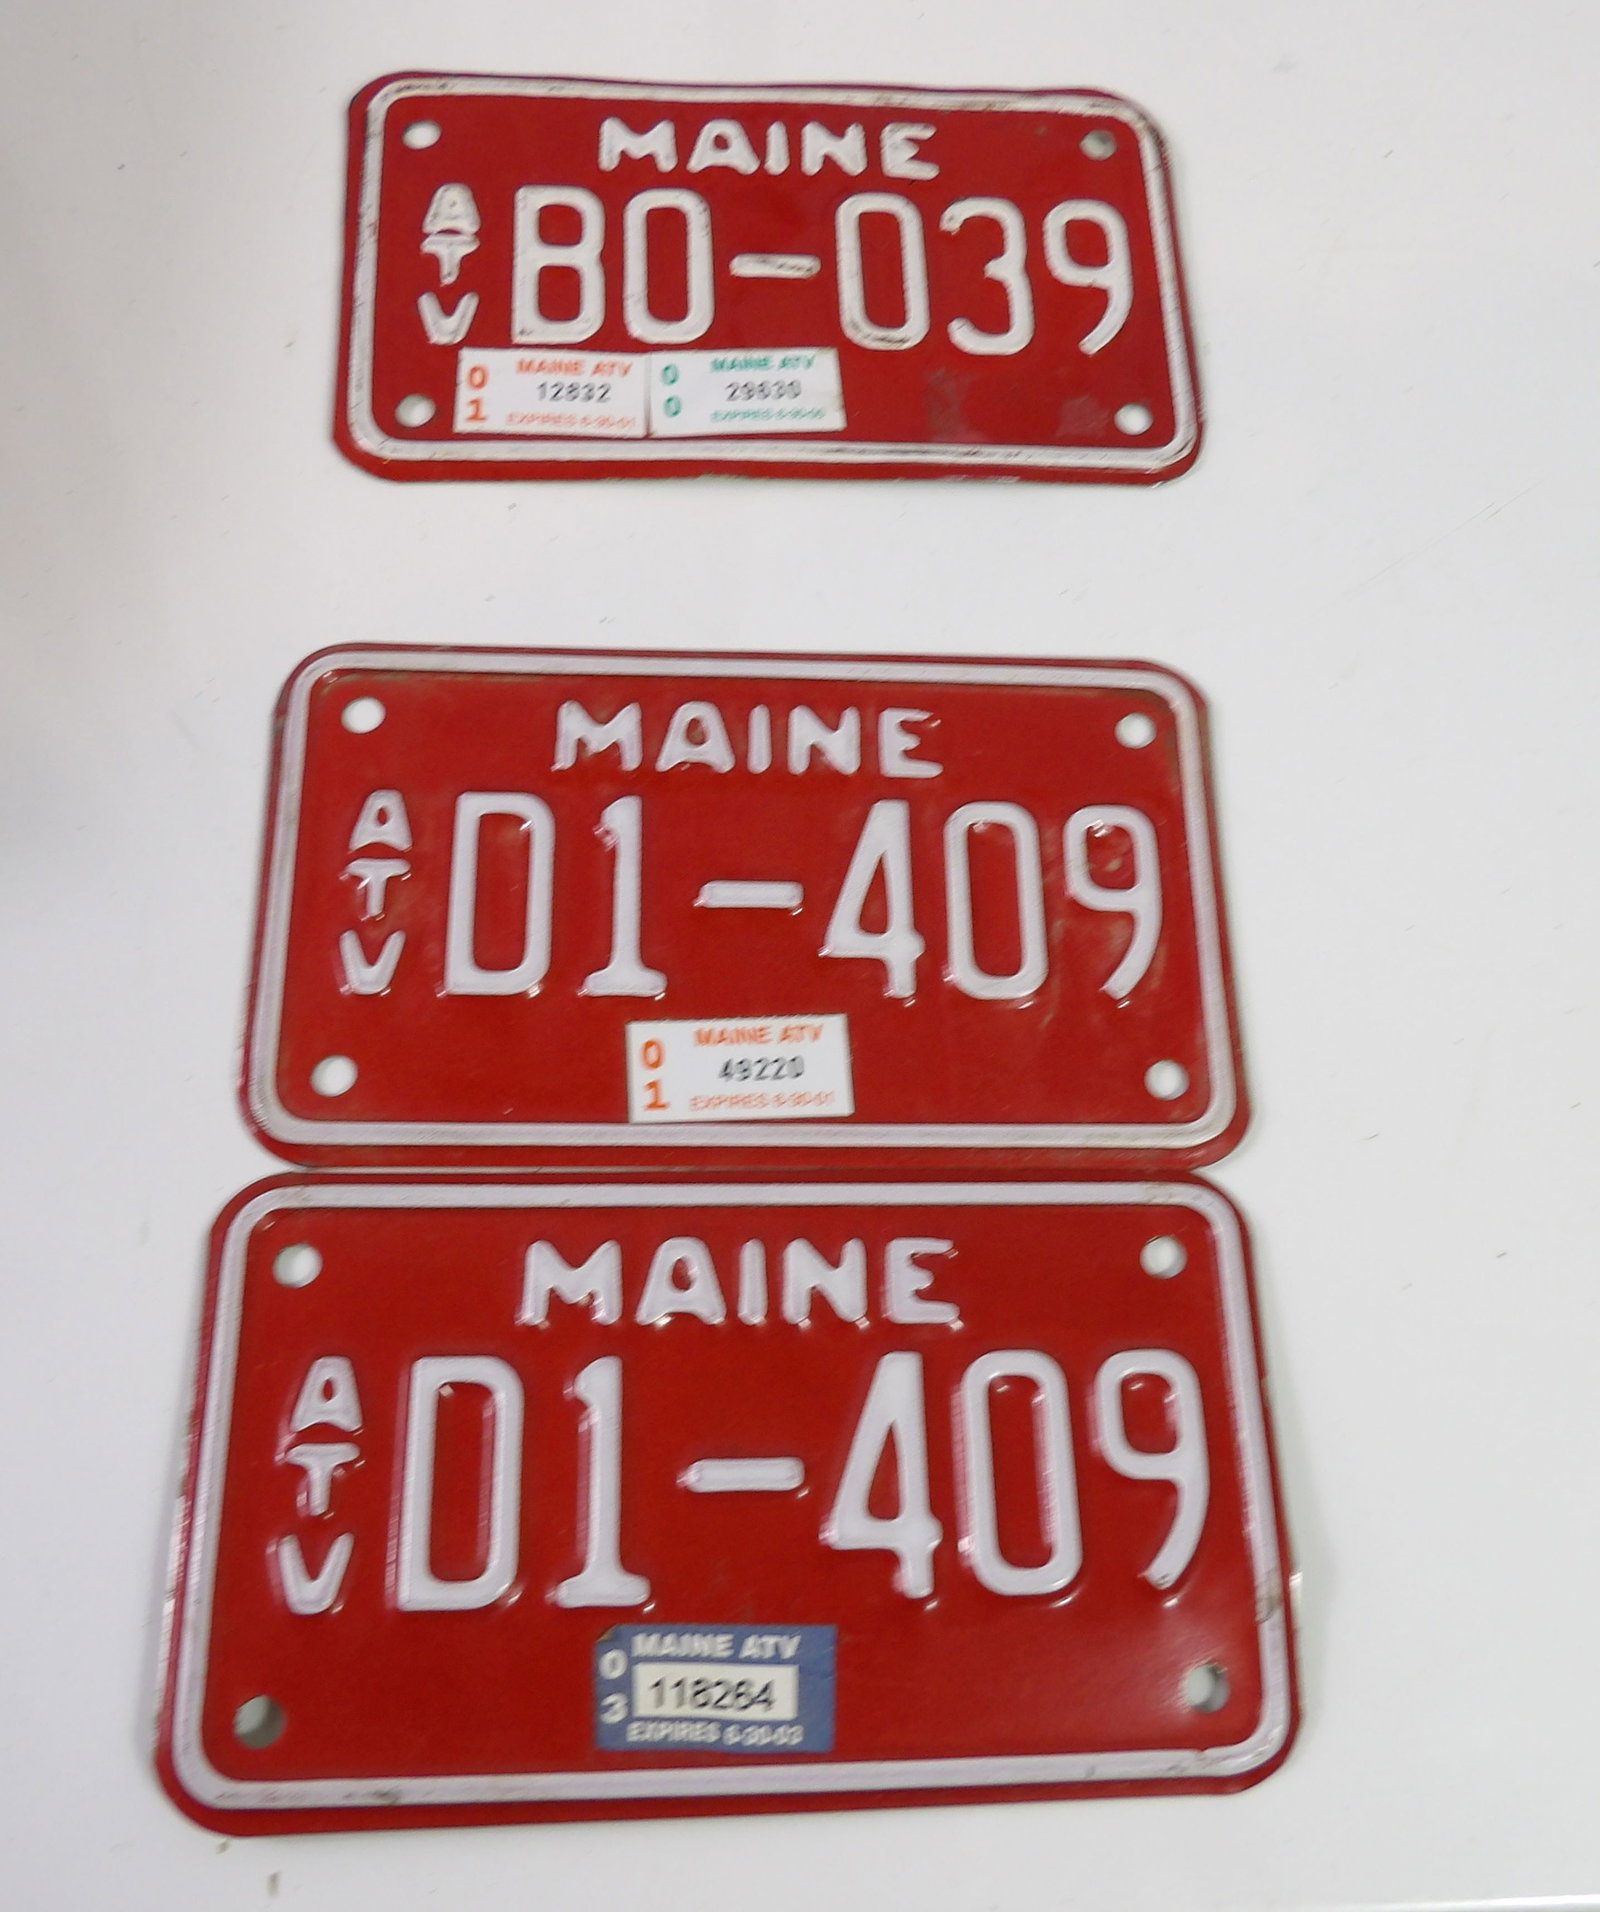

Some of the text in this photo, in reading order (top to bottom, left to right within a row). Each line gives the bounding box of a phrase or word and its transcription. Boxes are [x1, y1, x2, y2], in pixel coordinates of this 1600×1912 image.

[600, 118, 940, 181] MAINE
[418, 182, 481, 345] ATV
[516, 358, 633, 378] MAINE ATV
[711, 354, 816, 373] MAINE ATV
[551, 699, 943, 779] MAINE
[338, 789, 411, 997] ATV
[440, 791, 1163, 1002] D1-409
[694, 1024, 824, 1047] MAINE ATV
[718, 1055, 805, 1082] 49220
[689, 1092, 768, 1111] EXPIRES
[520, 1237, 960, 1329] MAINE
[272, 1353, 363, 1615] ATV
[390, 1349, 1209, 1612] D1-409
[631, 1632, 802, 1660] MAINE ATV
[626, 1720, 722, 1743] EXPIRES
